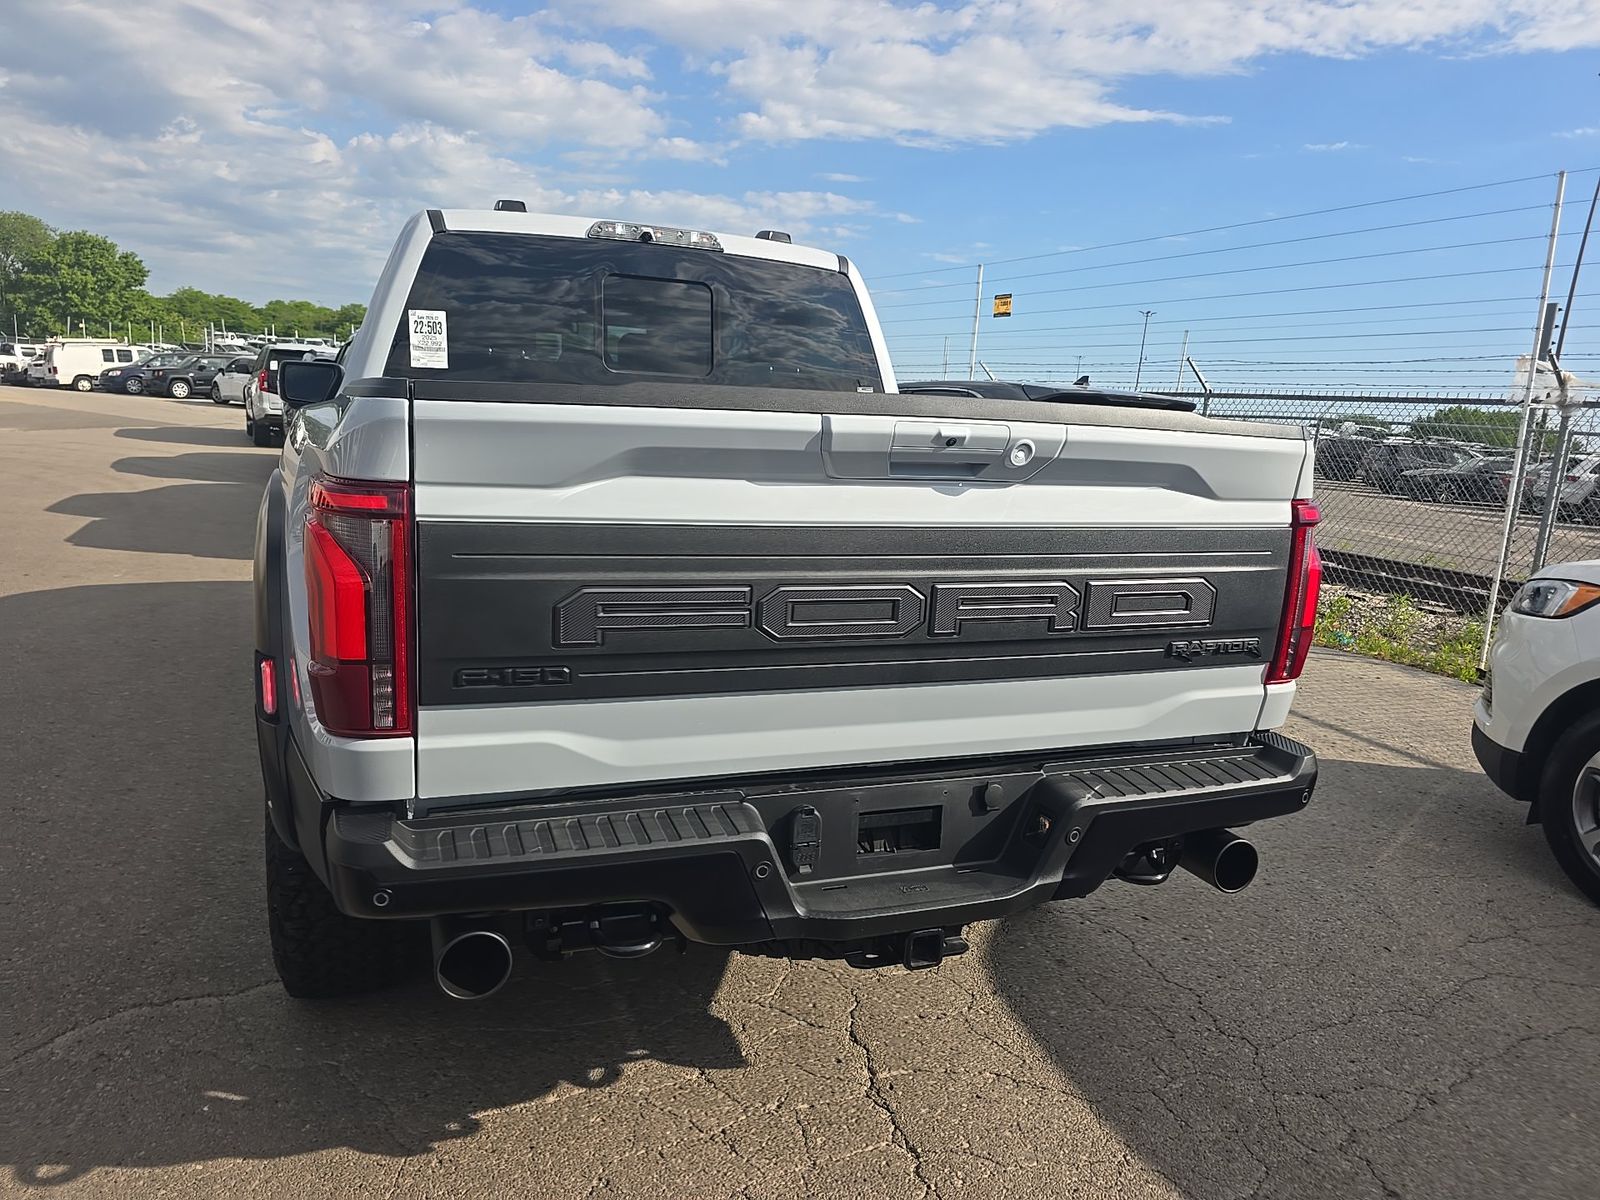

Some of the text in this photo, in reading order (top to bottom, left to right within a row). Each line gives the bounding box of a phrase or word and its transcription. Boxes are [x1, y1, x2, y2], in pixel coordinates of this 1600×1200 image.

[413, 320, 443, 335] 22:503
[552, 575, 1217, 650] FORD
[1168, 636, 1261, 660] RAPTOR
[453, 664, 572, 689] F-150
